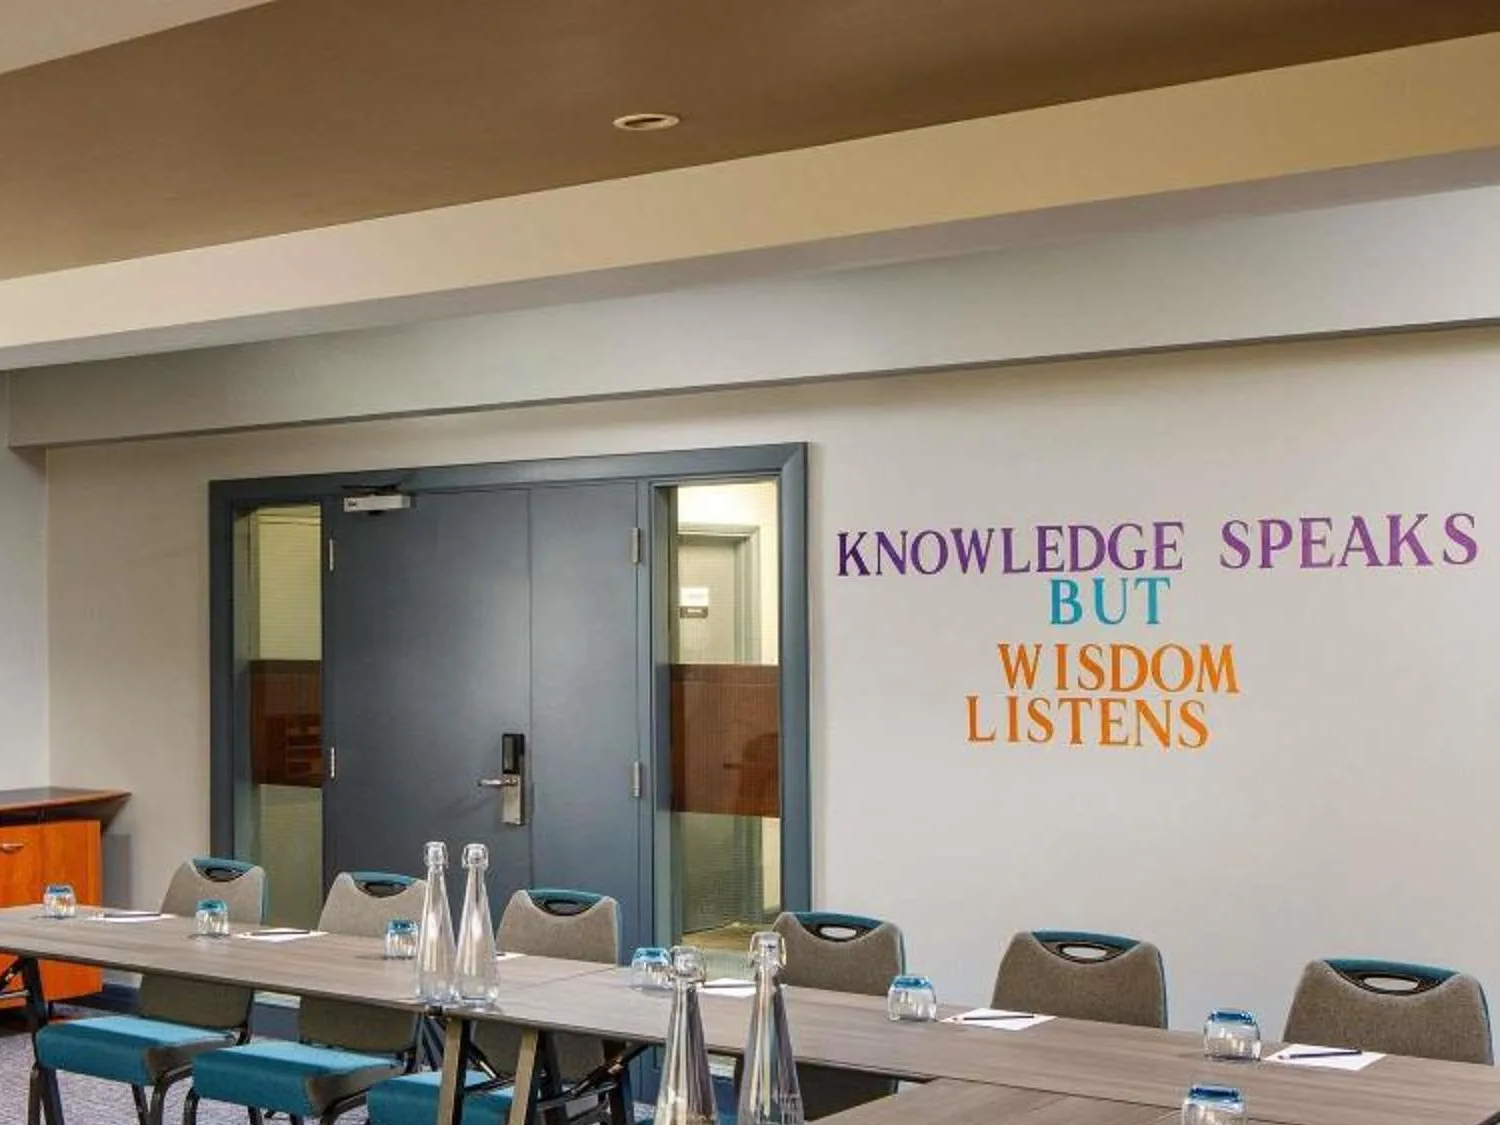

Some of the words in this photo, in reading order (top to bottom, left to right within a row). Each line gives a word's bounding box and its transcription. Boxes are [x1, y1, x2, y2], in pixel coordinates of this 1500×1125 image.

[836, 521, 1185, 577] KNOWLEDGE
[1219, 512, 1479, 569] SPEAKS
[1049, 576, 1171, 627] BUT
[997, 642, 1241, 694] WISDOM
[965, 695, 1210, 750] LISTENS
